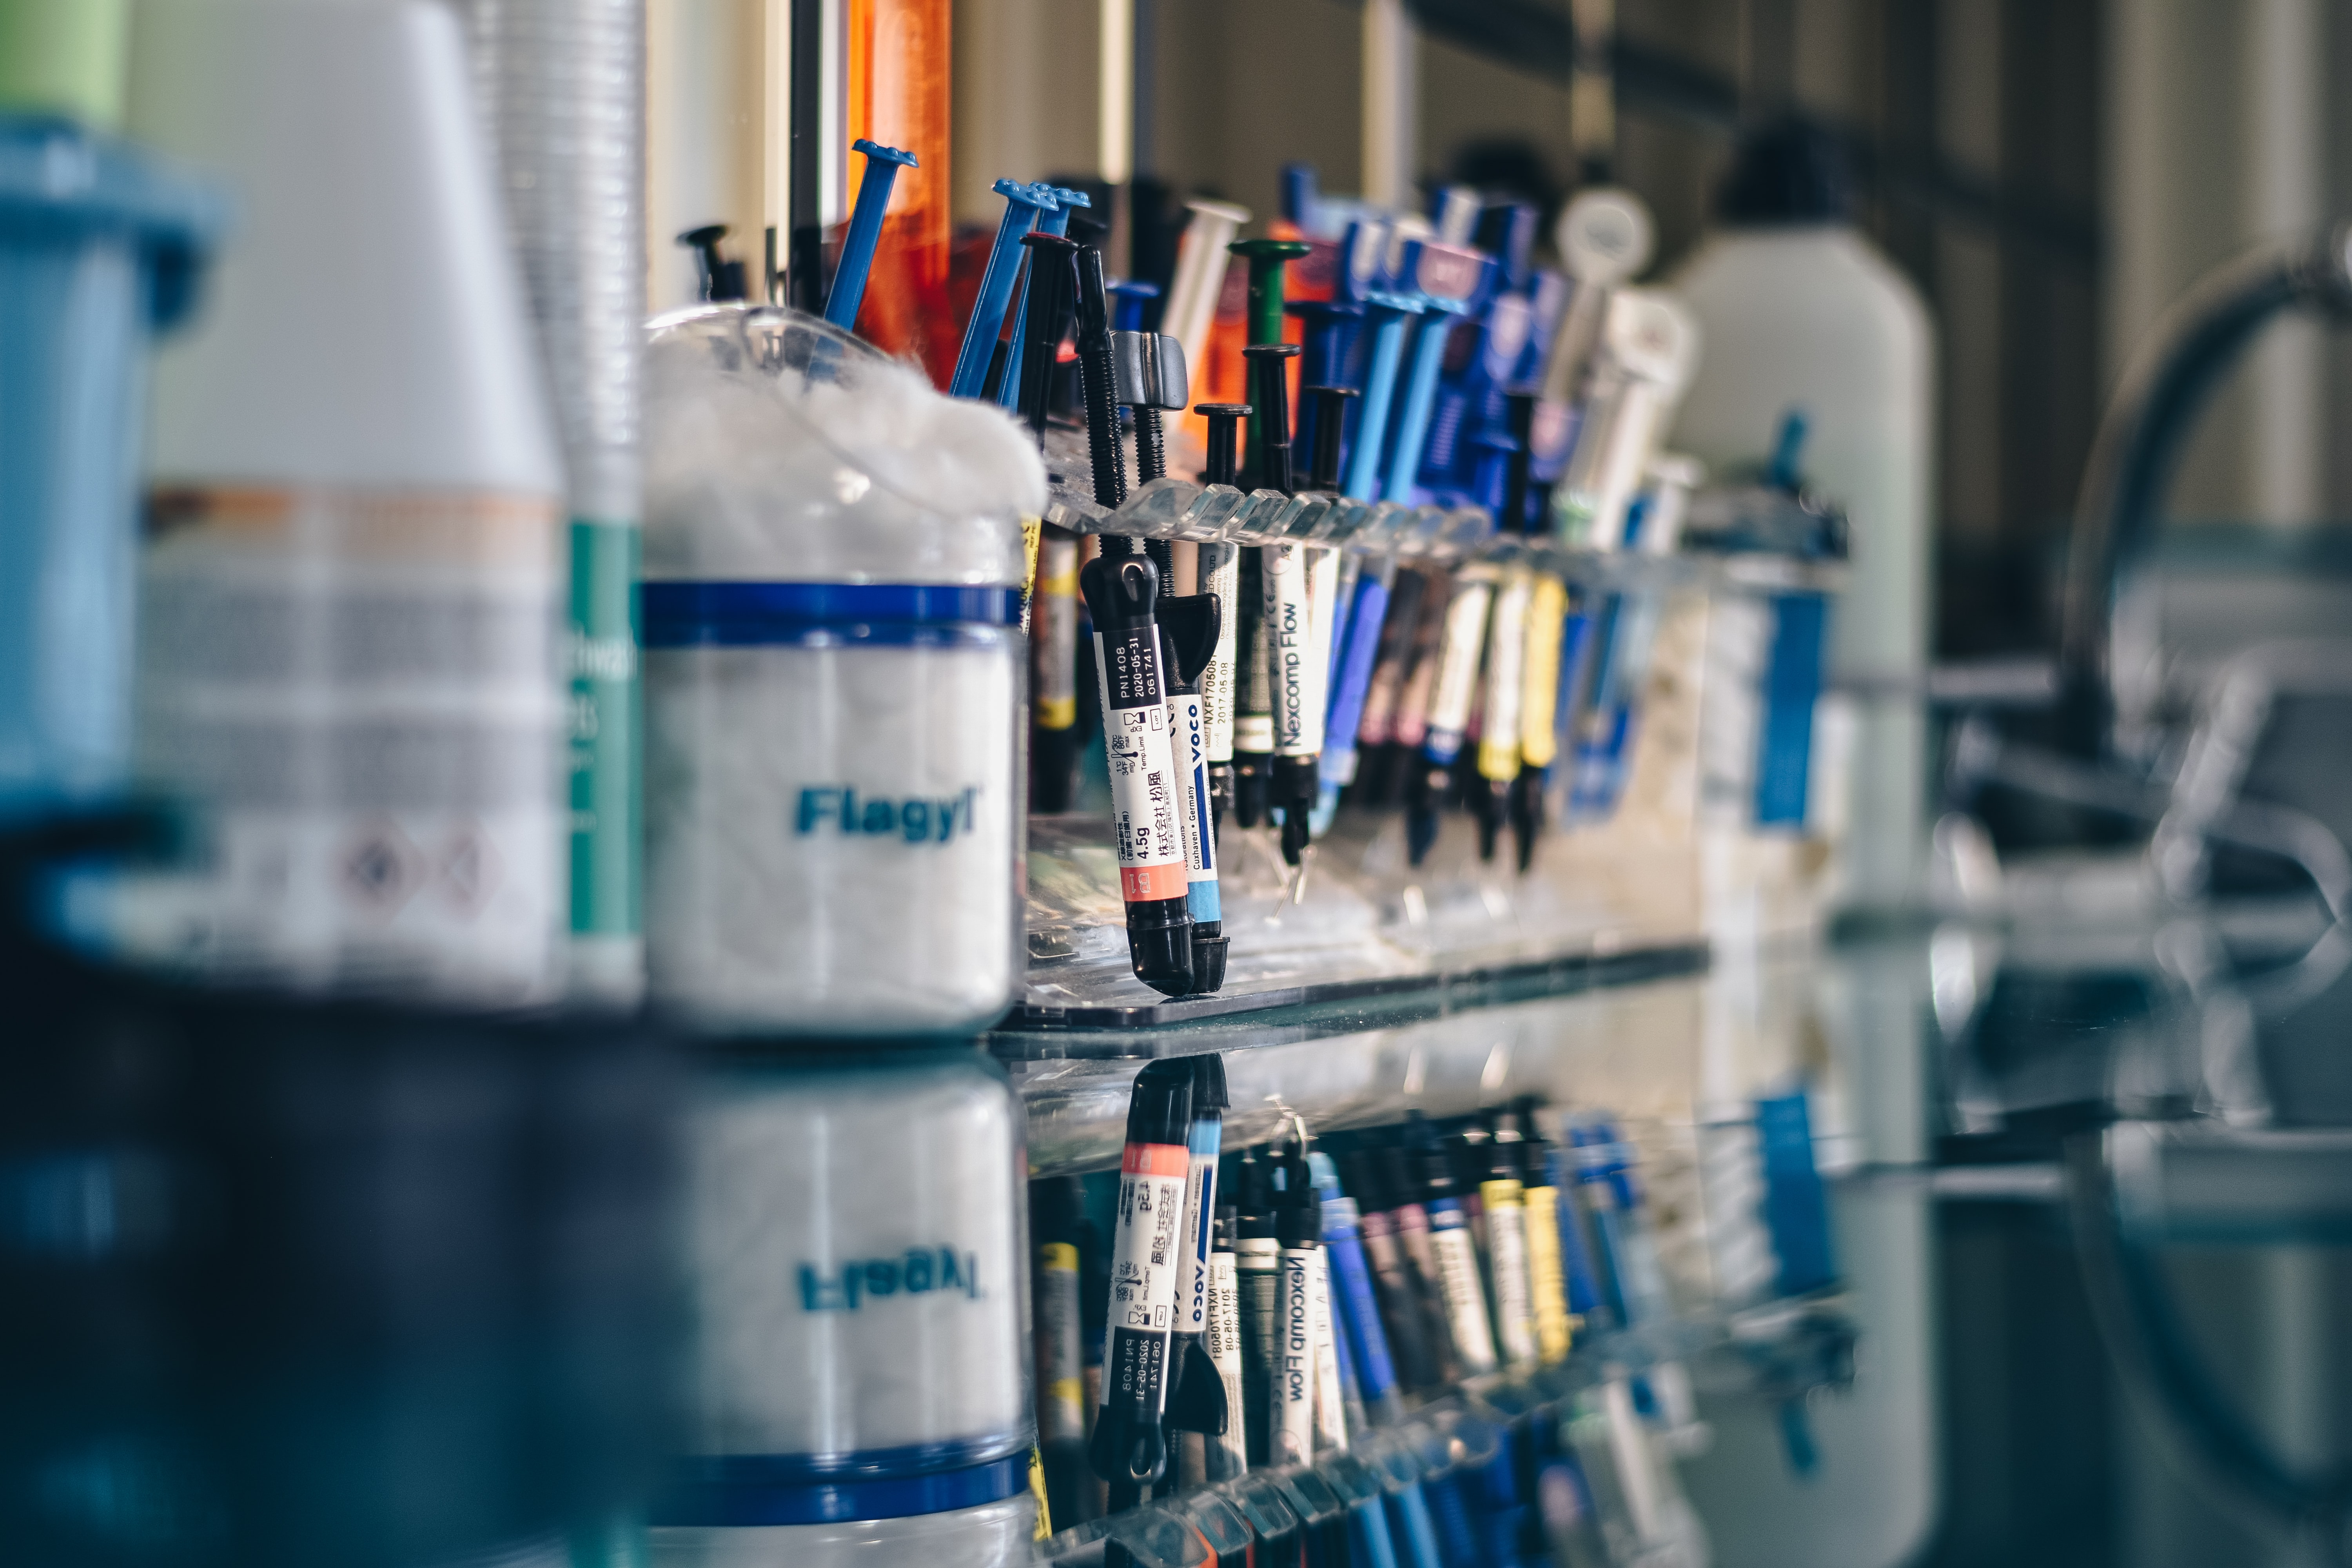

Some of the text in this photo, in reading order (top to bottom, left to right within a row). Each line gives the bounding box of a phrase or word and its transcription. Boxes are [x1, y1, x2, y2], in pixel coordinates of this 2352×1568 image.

[1116, 646, 1130, 698] PN1408
[1129, 637, 1145, 697] 2020-05-31
[1143, 648, 1156, 695] 061741
[1217, 662, 1229, 724] 2017-05-08
[1280, 602, 1302, 747] Nexcomp Flow
[1138, 736, 1148, 771] Temp.Limit
[1188, 704, 1201, 763] VOCO
[796, 783, 976, 843] Flagyl
[1135, 827, 1150, 859] 4.5g
[1147, 770, 1170, 857] 株式会社 松風
[1187, 786, 1200, 870] Cuxhaven Germany
